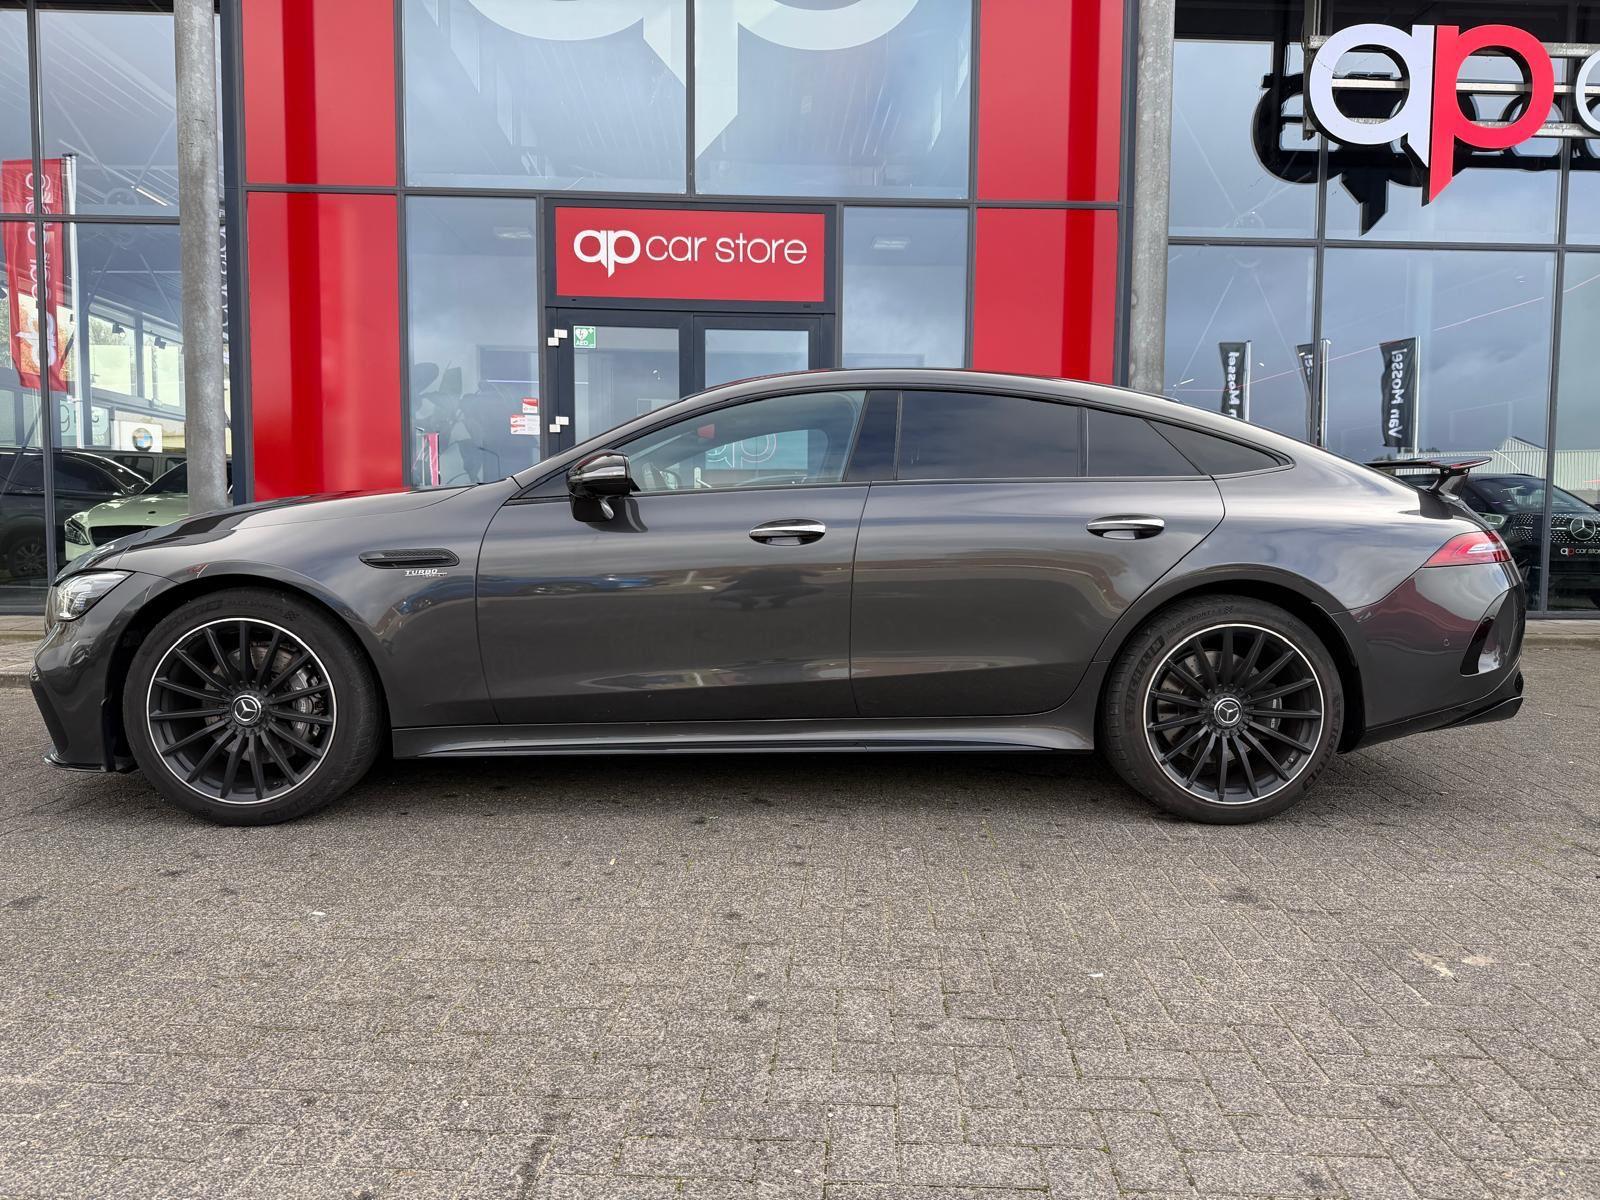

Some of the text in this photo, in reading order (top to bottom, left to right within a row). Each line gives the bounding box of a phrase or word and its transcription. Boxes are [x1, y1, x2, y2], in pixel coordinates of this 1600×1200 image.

[1309, 23, 1555, 204] ap
[573, 229, 808, 278] ap car store
